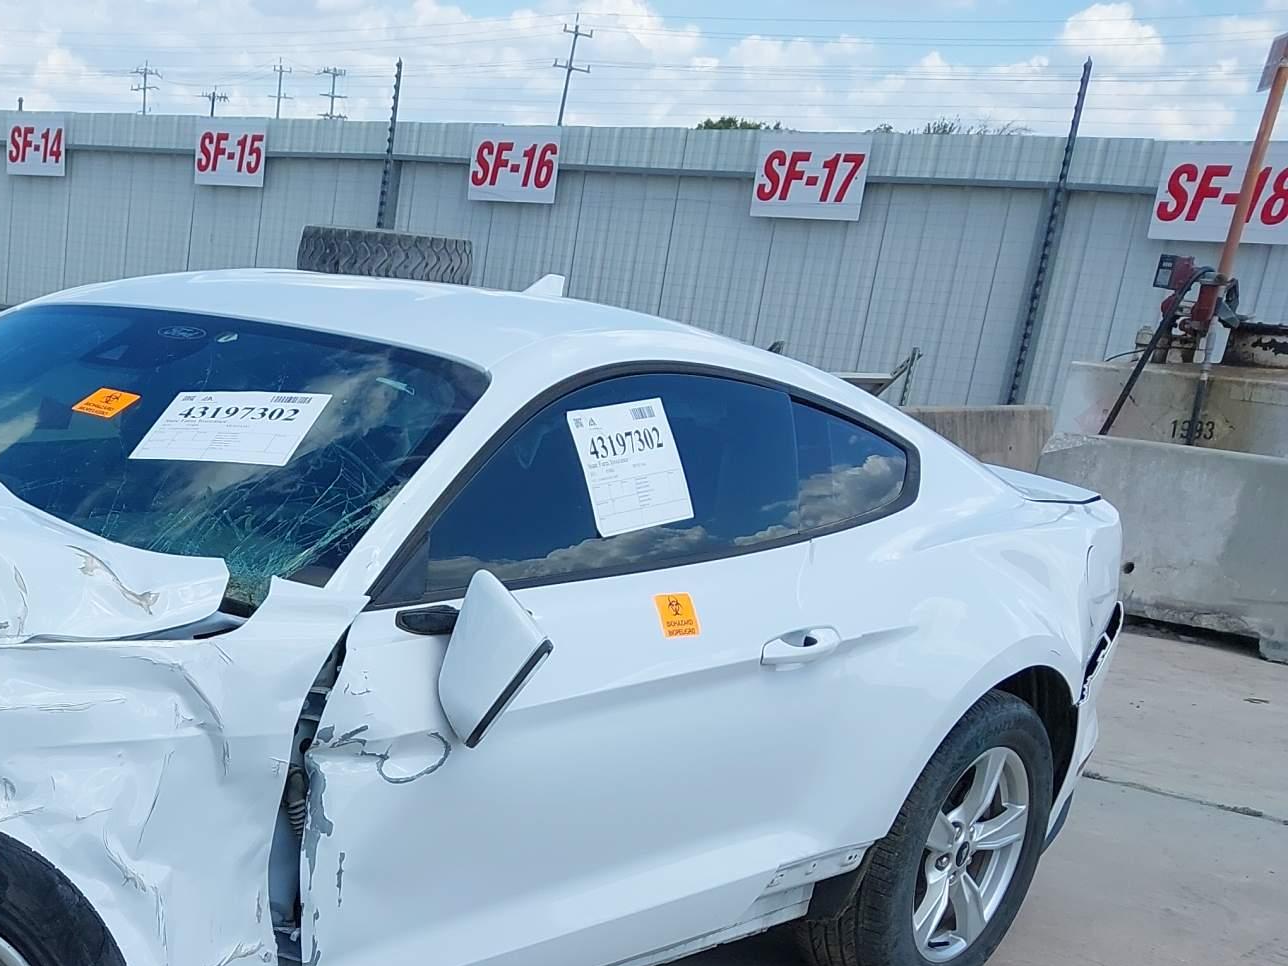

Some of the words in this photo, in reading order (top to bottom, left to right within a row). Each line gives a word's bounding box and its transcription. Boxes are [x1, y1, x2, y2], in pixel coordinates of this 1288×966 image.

[8, 125, 63, 164] SF-14
[196, 131, 264, 175] SF-15
[471, 140, 558, 189] SF-16
[756, 149, 866, 203] SF-17
[1156, 163, 1288, 226] SF-18
[178, 406, 300, 421] 43197302
[589, 427, 663, 459] 43197302
